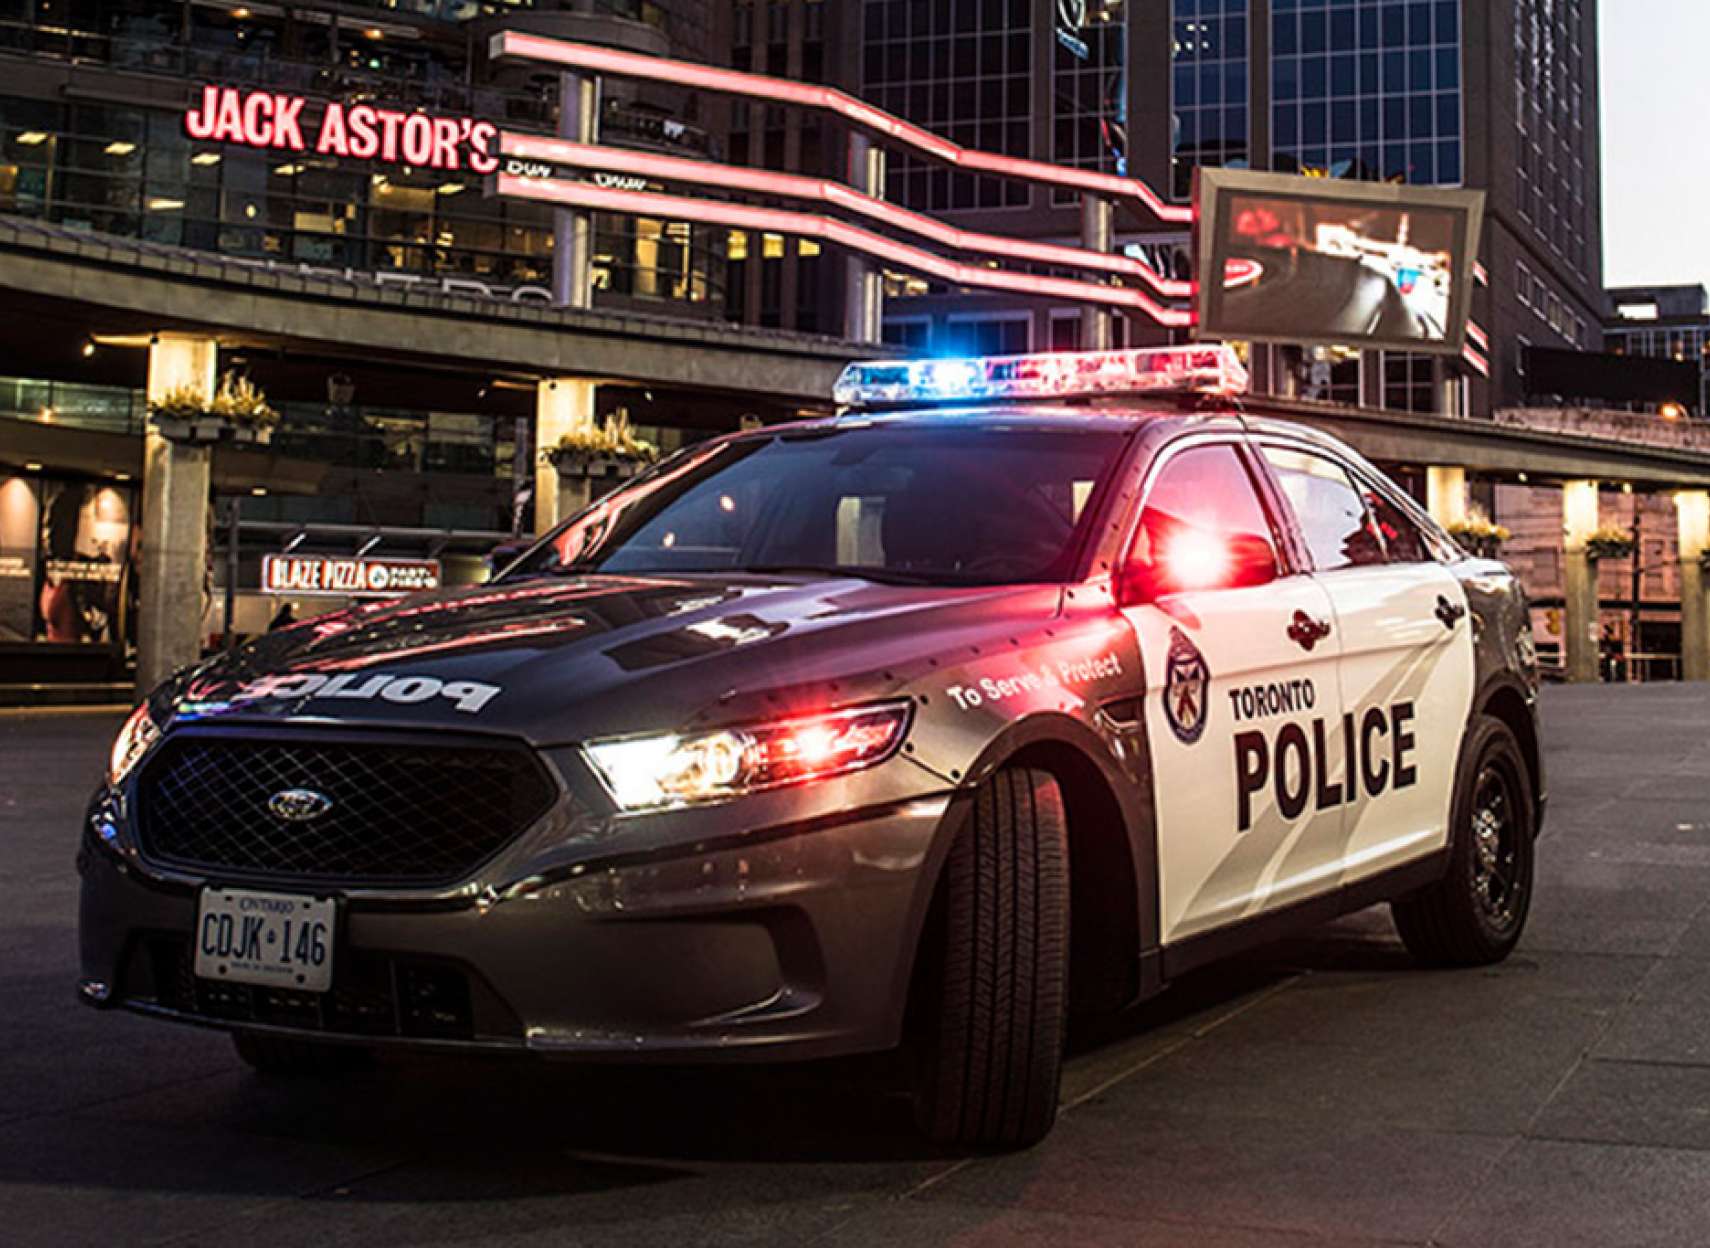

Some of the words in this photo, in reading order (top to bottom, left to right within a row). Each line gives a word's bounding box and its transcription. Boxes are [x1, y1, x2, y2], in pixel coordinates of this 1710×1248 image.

[185, 84, 305, 150] JACK
[316, 101, 499, 174] ASTOR'S
[323, 559, 367, 589] PIZZA
[947, 686, 983, 711] To
[1058, 652, 1123, 684] Protect
[1229, 679, 1315, 720] TORONTO
[1233, 701, 1418, 833] POLICE
[202, 912, 265, 961] CDJK
[280, 919, 326, 966] 146
